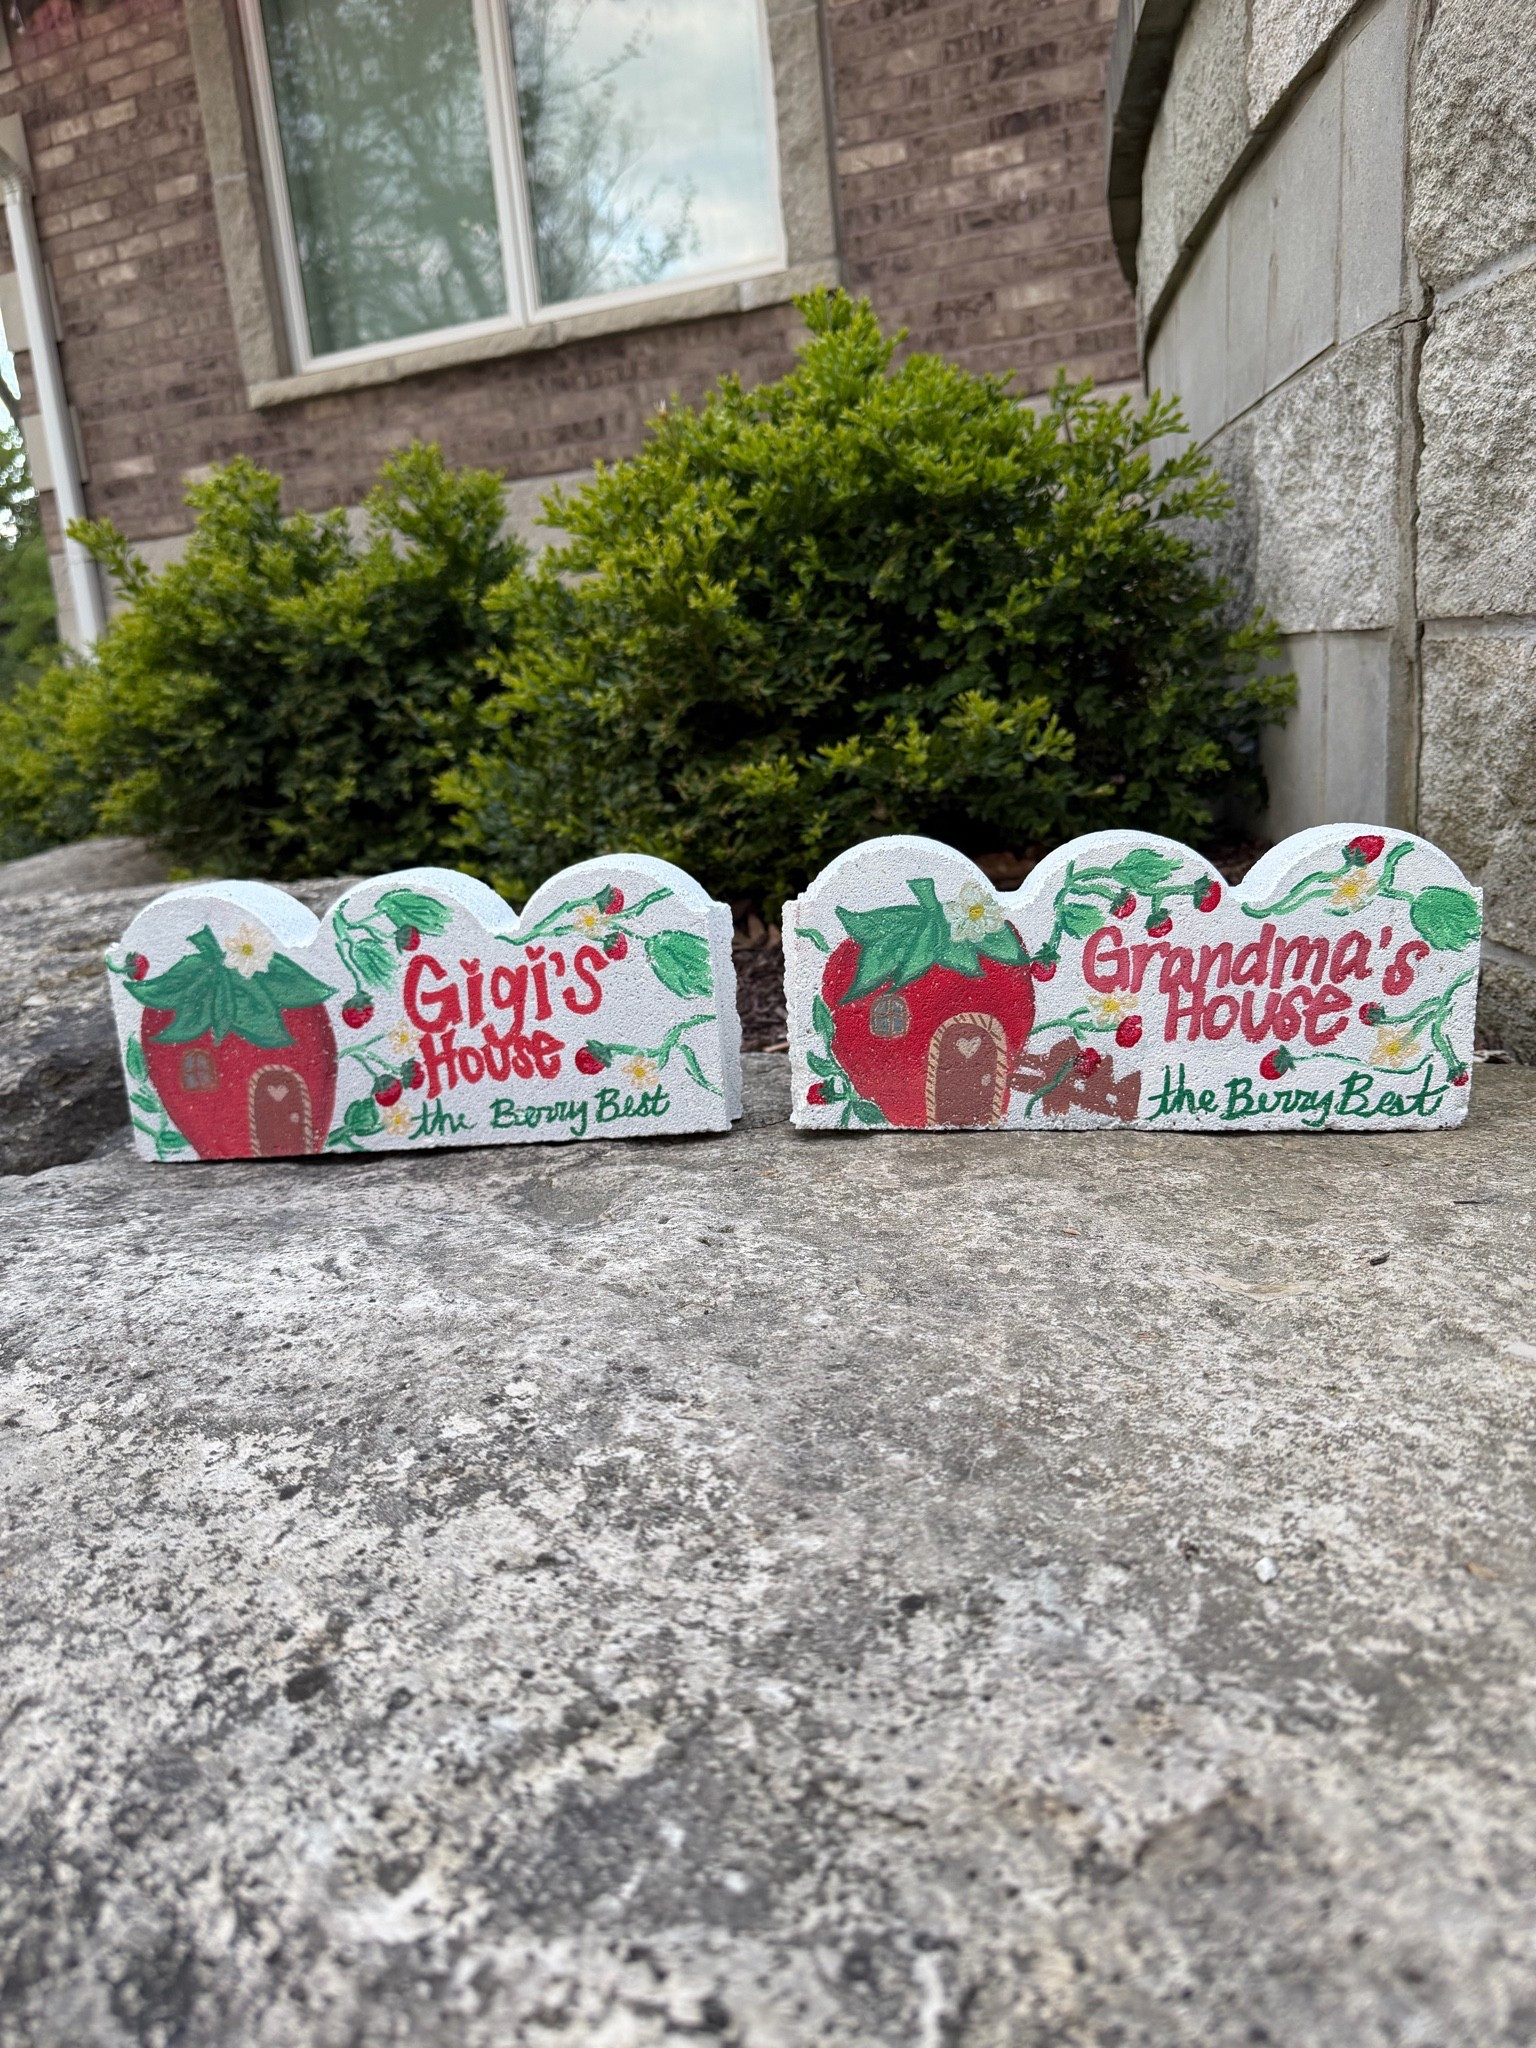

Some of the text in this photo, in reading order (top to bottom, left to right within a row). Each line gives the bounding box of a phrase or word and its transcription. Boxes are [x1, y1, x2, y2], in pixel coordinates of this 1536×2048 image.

[404, 945, 610, 1037] Gigi's
[1081, 924, 1430, 996] Grandma's
[1164, 983, 1353, 1045] House
[418, 1026, 566, 1099] House
[1146, 1063, 1450, 1127] the Berry Best
[407, 1084, 671, 1139] the Berry Best
